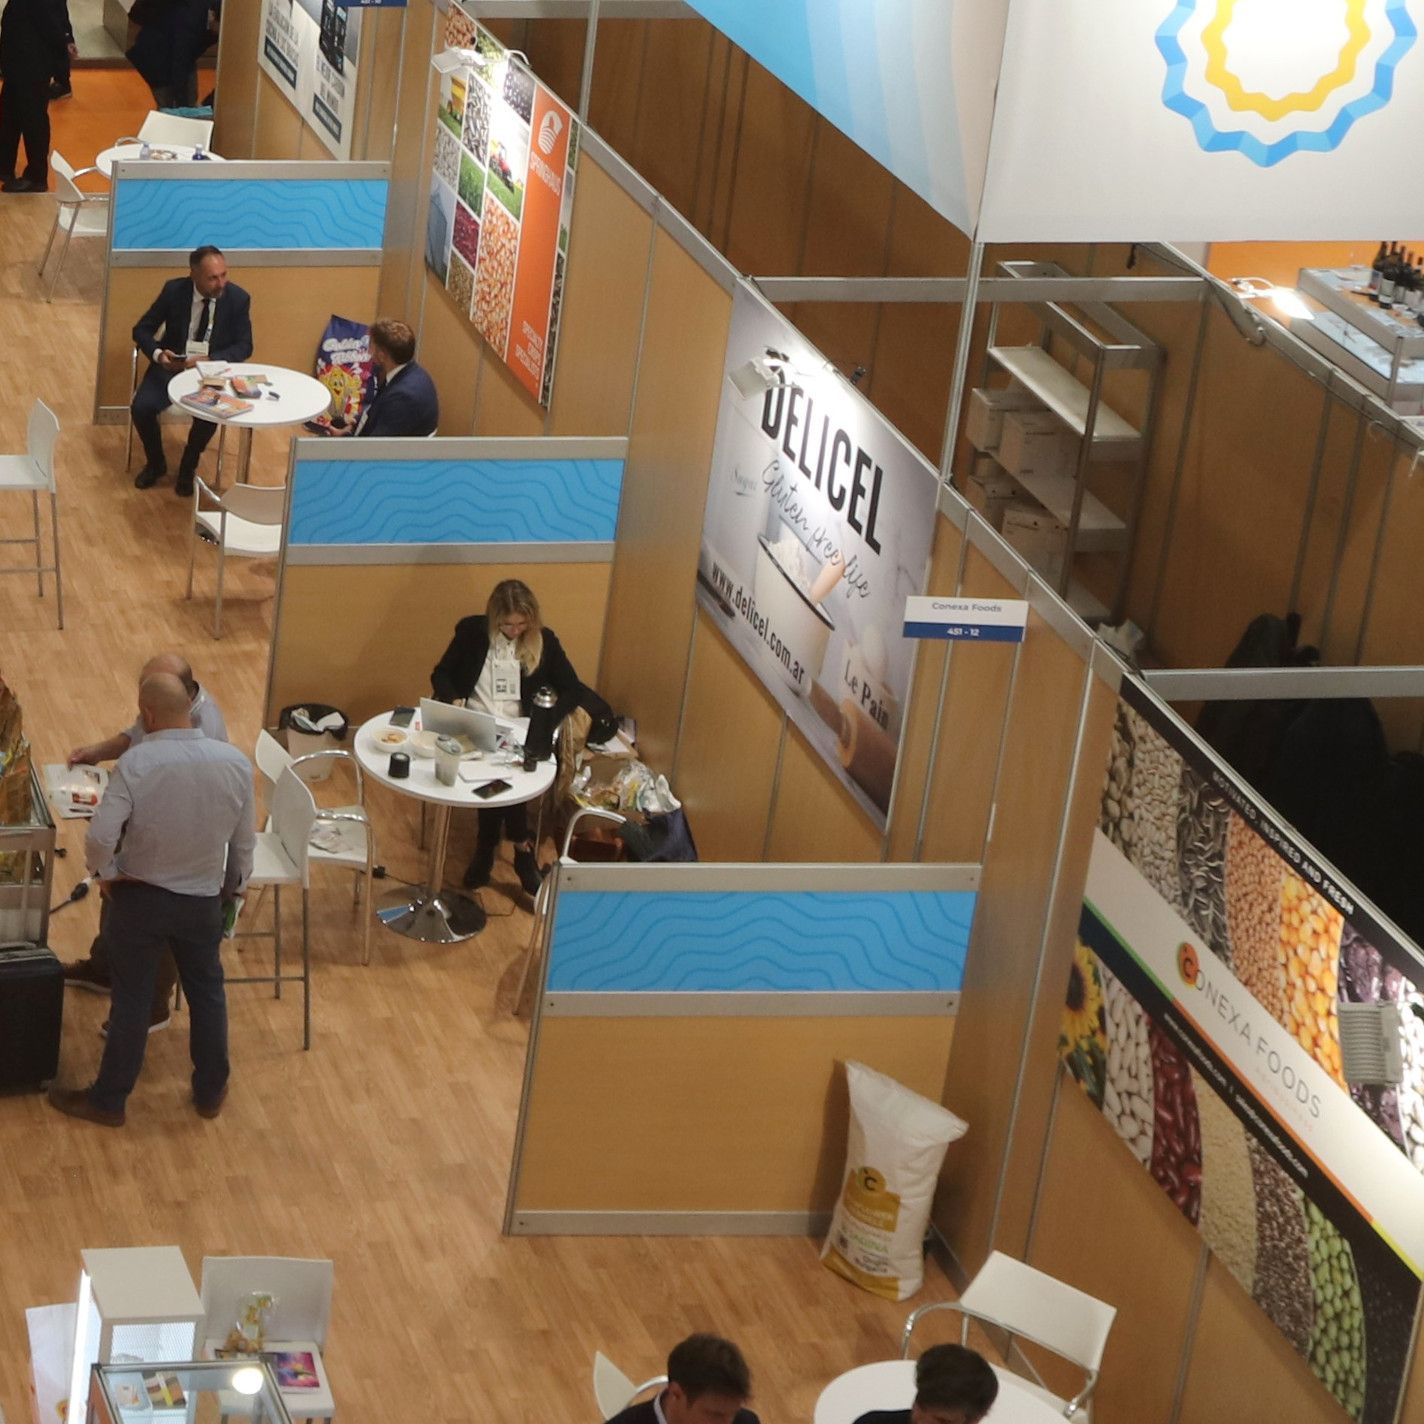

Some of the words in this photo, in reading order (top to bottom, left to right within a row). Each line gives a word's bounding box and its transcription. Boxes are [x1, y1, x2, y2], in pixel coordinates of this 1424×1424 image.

[761, 370, 884, 557] DELICEL
[711, 561, 805, 685] www.delicel.com.ar
[932, 601, 969, 612] Conexa
[971, 602, 1002, 613] Foods
[860, 678, 890, 731] Pain
[1301, 857, 1325, 885] AND
[1323, 879, 1356, 916] FRESH
[1255, 1033, 1322, 1120] FOODS
